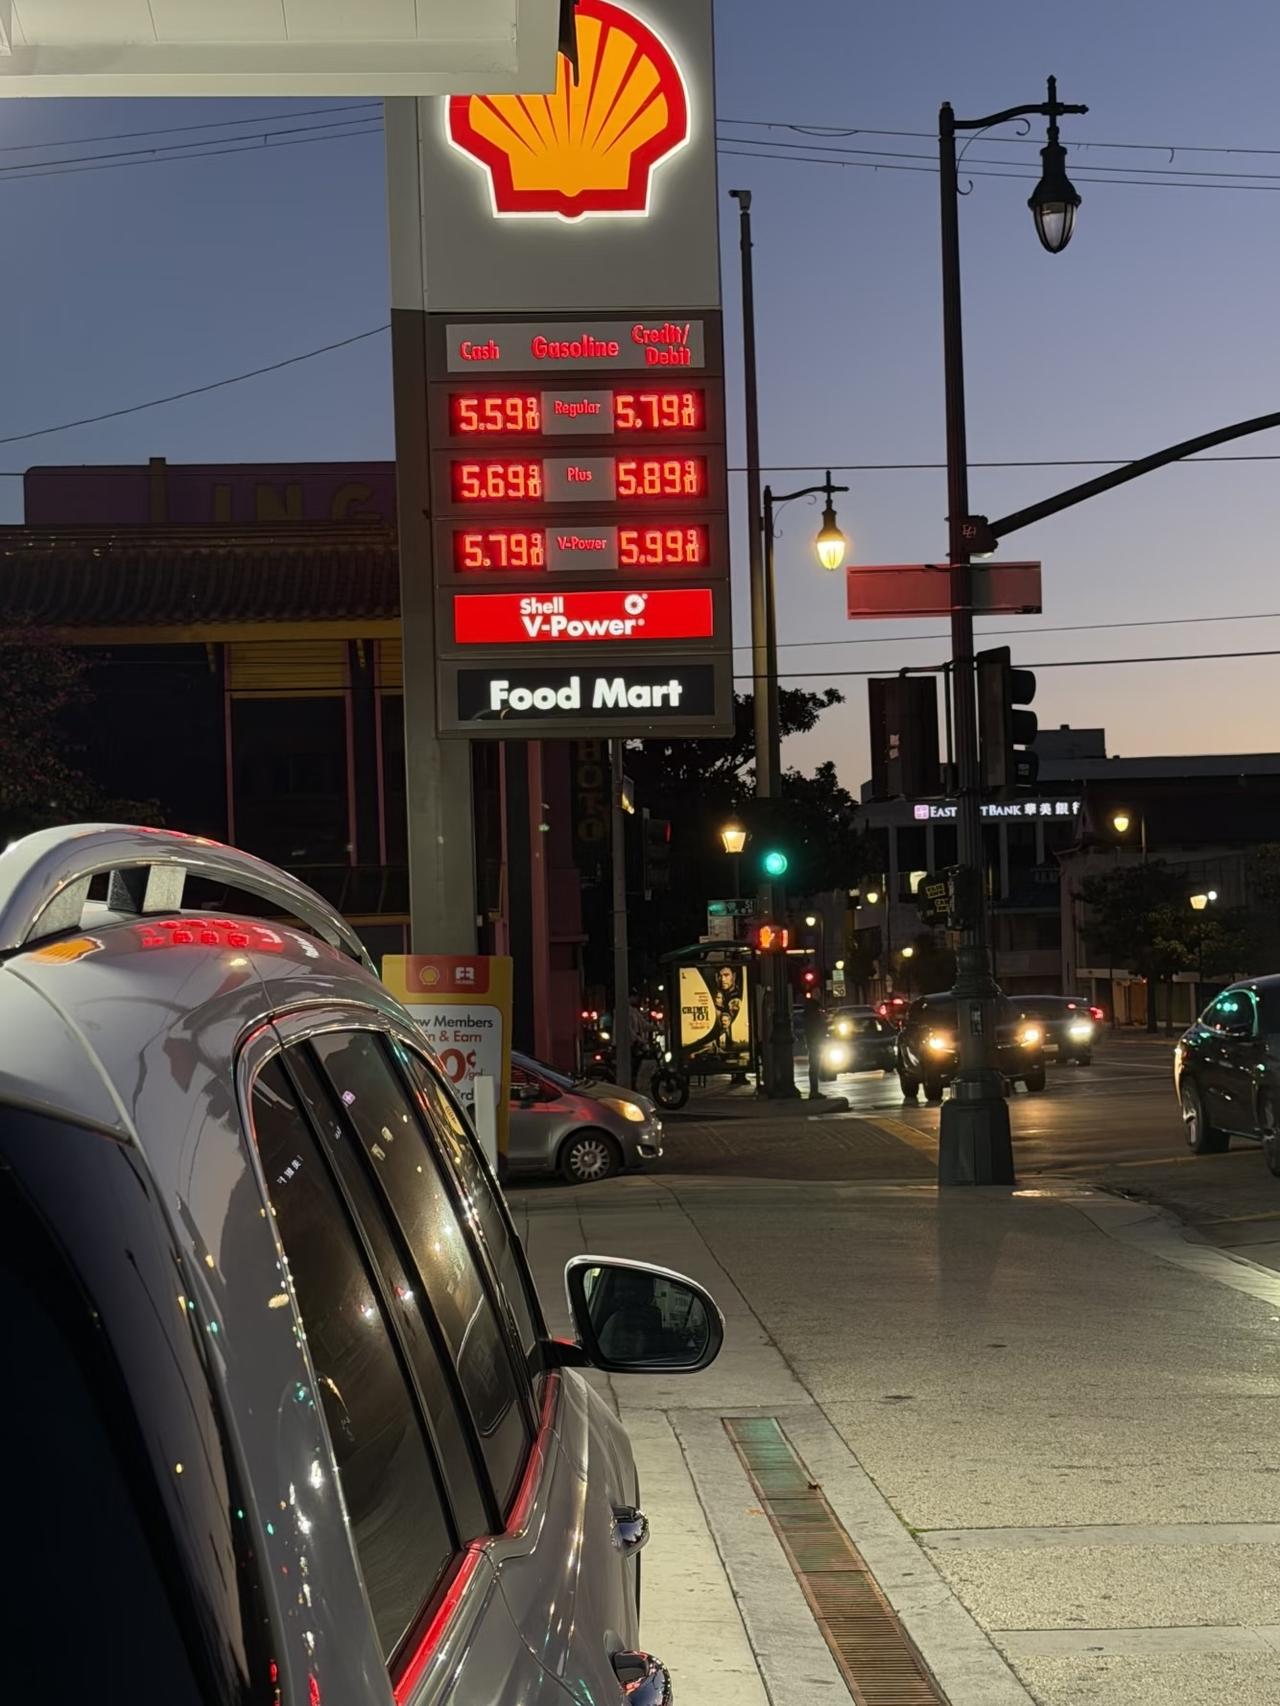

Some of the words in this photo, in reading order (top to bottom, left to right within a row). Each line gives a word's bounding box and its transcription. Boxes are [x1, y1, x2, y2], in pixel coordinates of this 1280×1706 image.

[460, 340, 500, 360] Cash
[532, 334, 620, 360] Gasoline
[646, 346, 692, 367] Debit
[554, 400, 601, 418] Regular
[567, 467, 593, 482] Plus
[557, 536, 607, 550] V-Power
[520, 596, 564, 615] Shell
[490, 676, 581, 710] Food
[592, 677, 683, 709] Mart
[682, 1006, 709, 1014] CRIME
[693, 1012, 709, 1021] 101
[434, 1014, 494, 1028] Members
[440, 1030, 449, 1042] &
[454, 1030, 482, 1042] Earn
